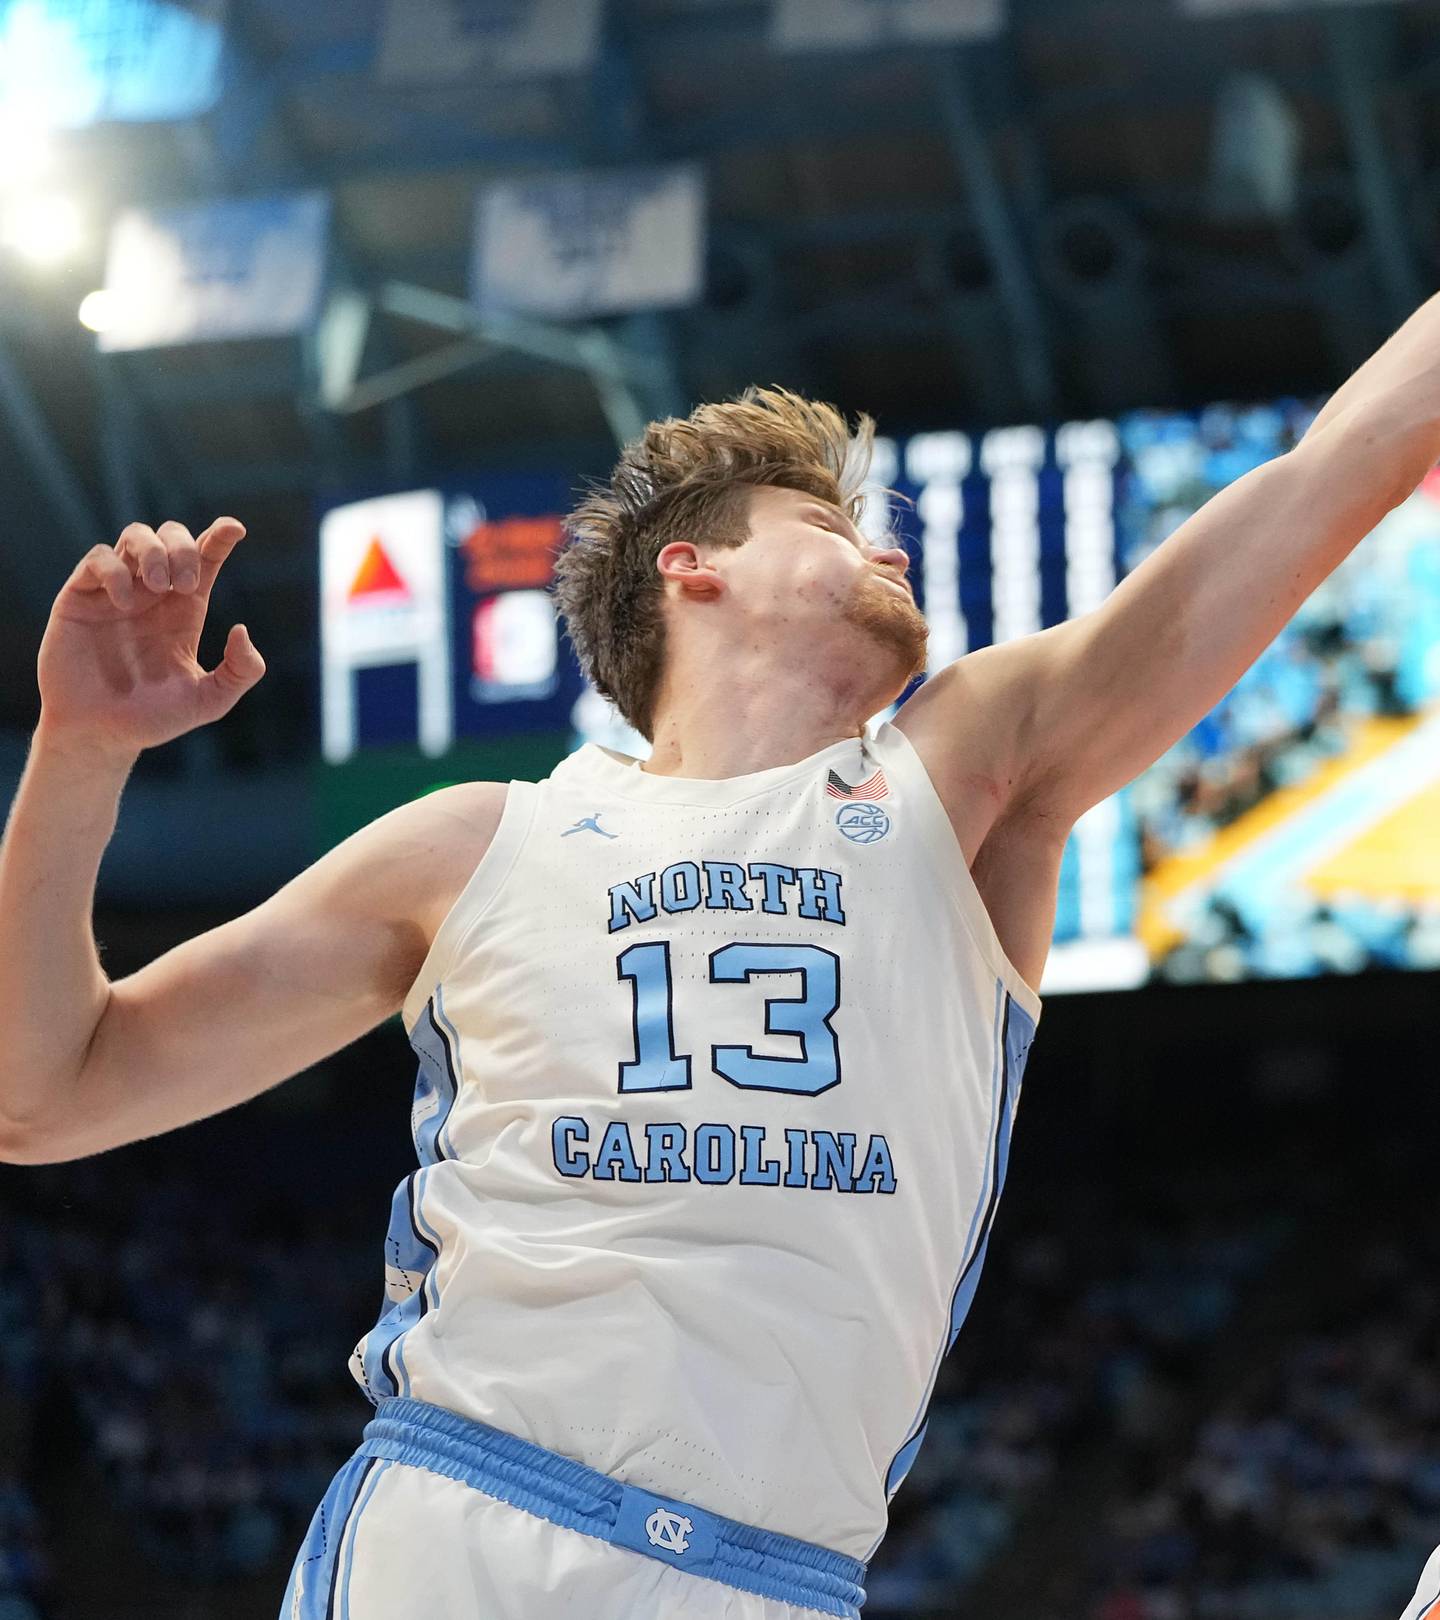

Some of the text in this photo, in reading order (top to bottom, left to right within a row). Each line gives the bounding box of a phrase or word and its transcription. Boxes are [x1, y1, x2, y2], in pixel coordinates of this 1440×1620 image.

[844, 815, 885, 826] ACC
[608, 861, 845, 933] NORTH
[616, 941, 842, 1097] 13
[552, 1116, 897, 1194] CAROLINA
